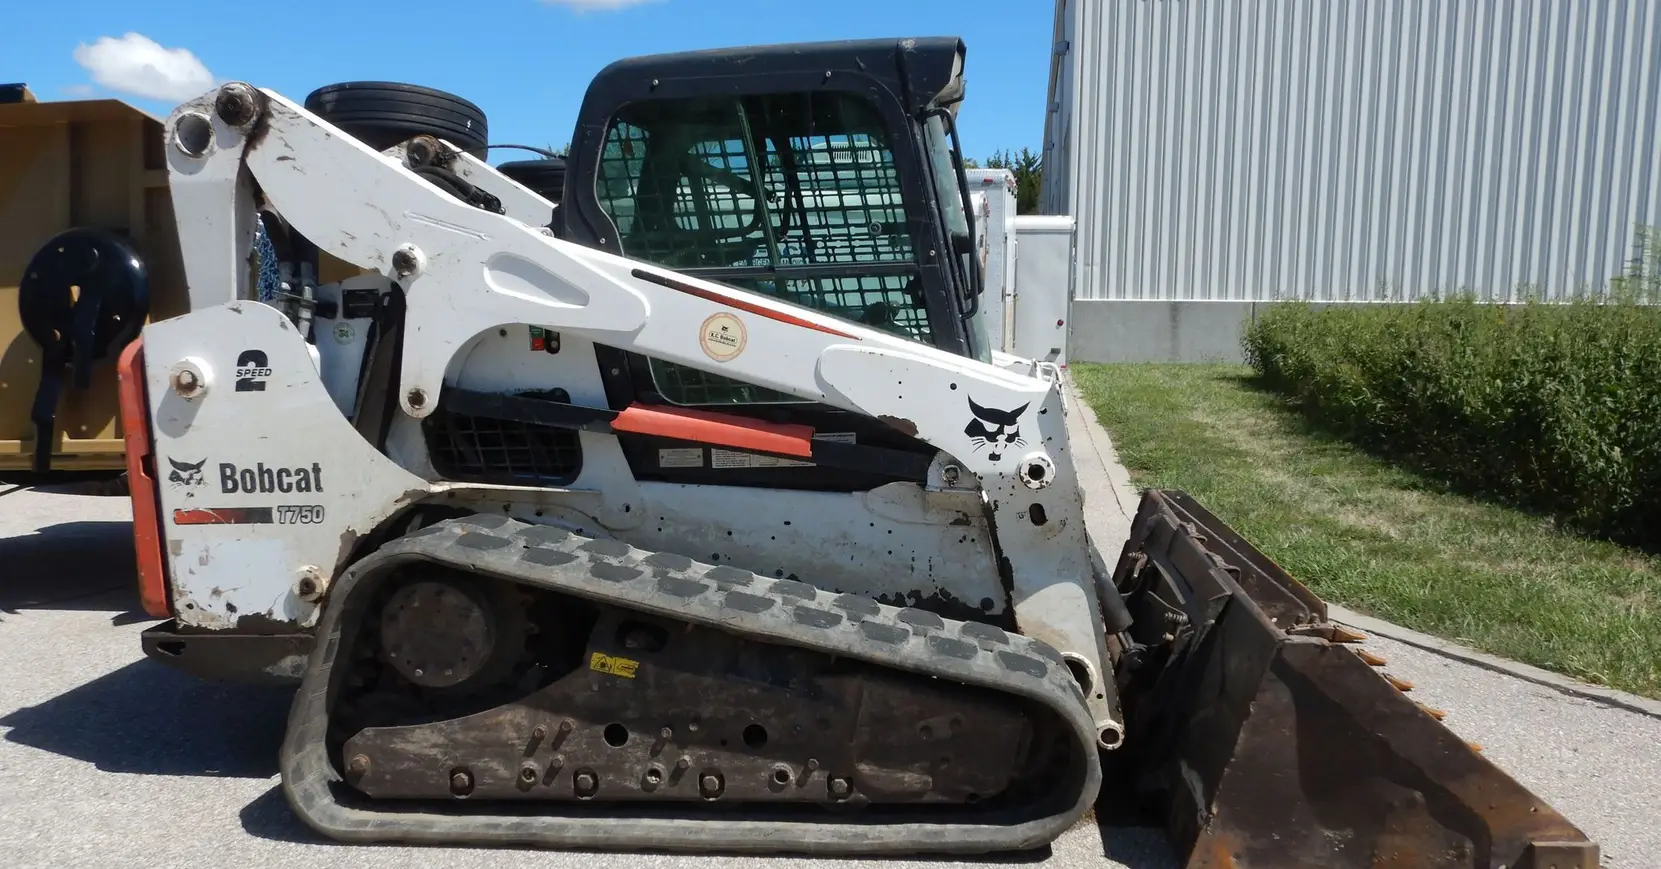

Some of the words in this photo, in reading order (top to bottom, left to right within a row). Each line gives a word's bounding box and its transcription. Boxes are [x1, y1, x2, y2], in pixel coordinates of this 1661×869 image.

[720, 334, 736, 343] Bobcat
[235, 349, 268, 392] 2
[235, 368, 272, 378] SPEED
[219, 462, 324, 494] Bobcat
[277, 504, 325, 525] T750
